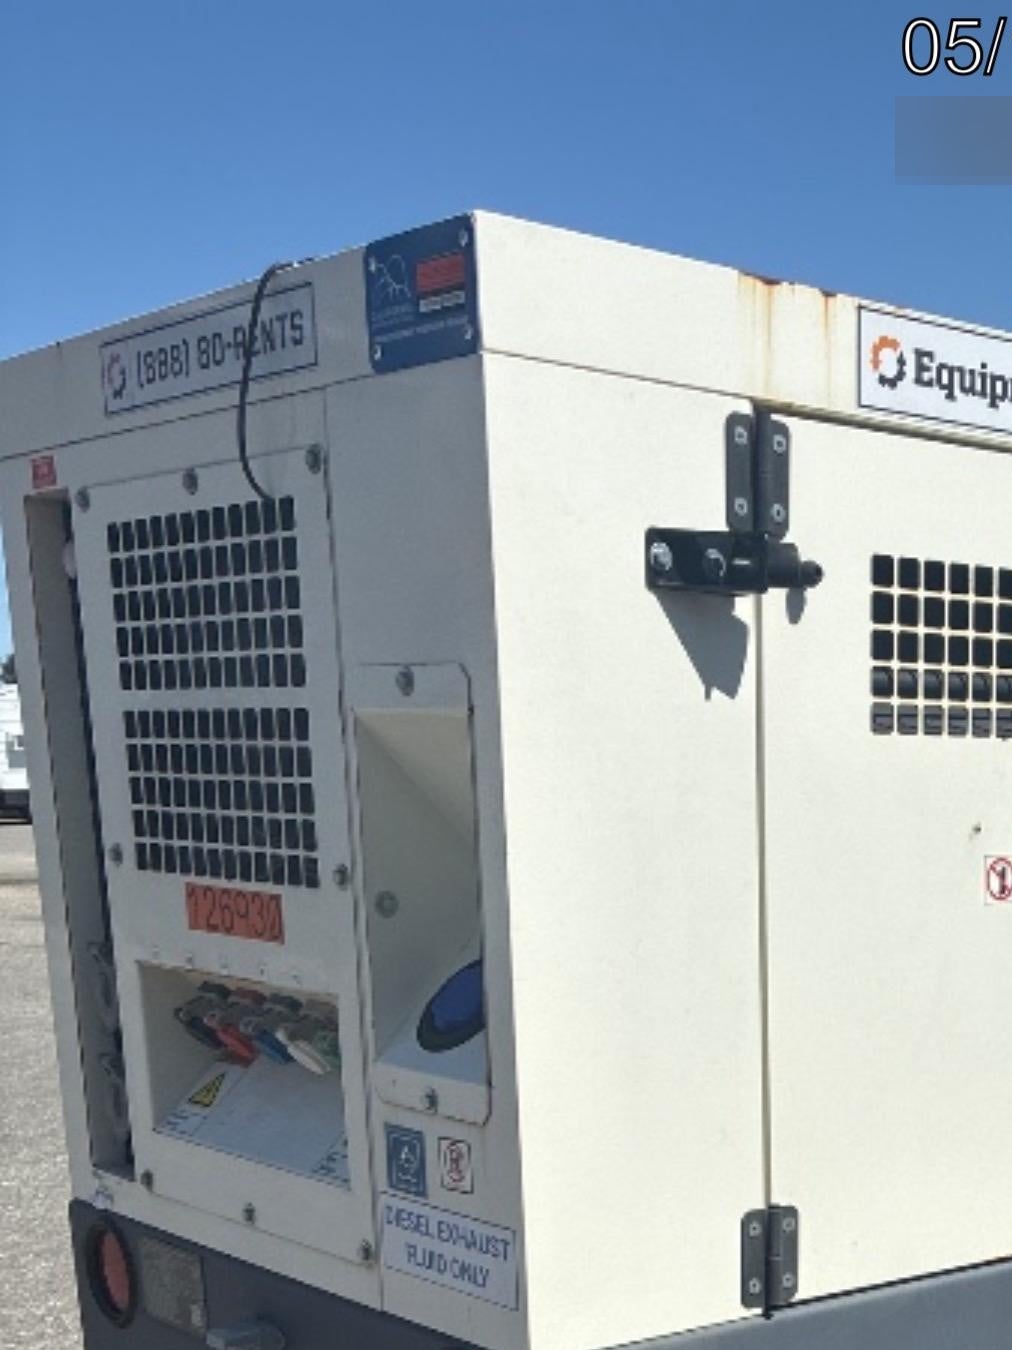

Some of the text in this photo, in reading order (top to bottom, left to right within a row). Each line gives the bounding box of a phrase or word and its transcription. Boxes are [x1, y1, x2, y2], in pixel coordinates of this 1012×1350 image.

[136, 338, 191, 389] (888)
[384, 1204, 511, 1262] DIESEL EXHAUST
[406, 1242, 490, 1289] FLUID ONLY
